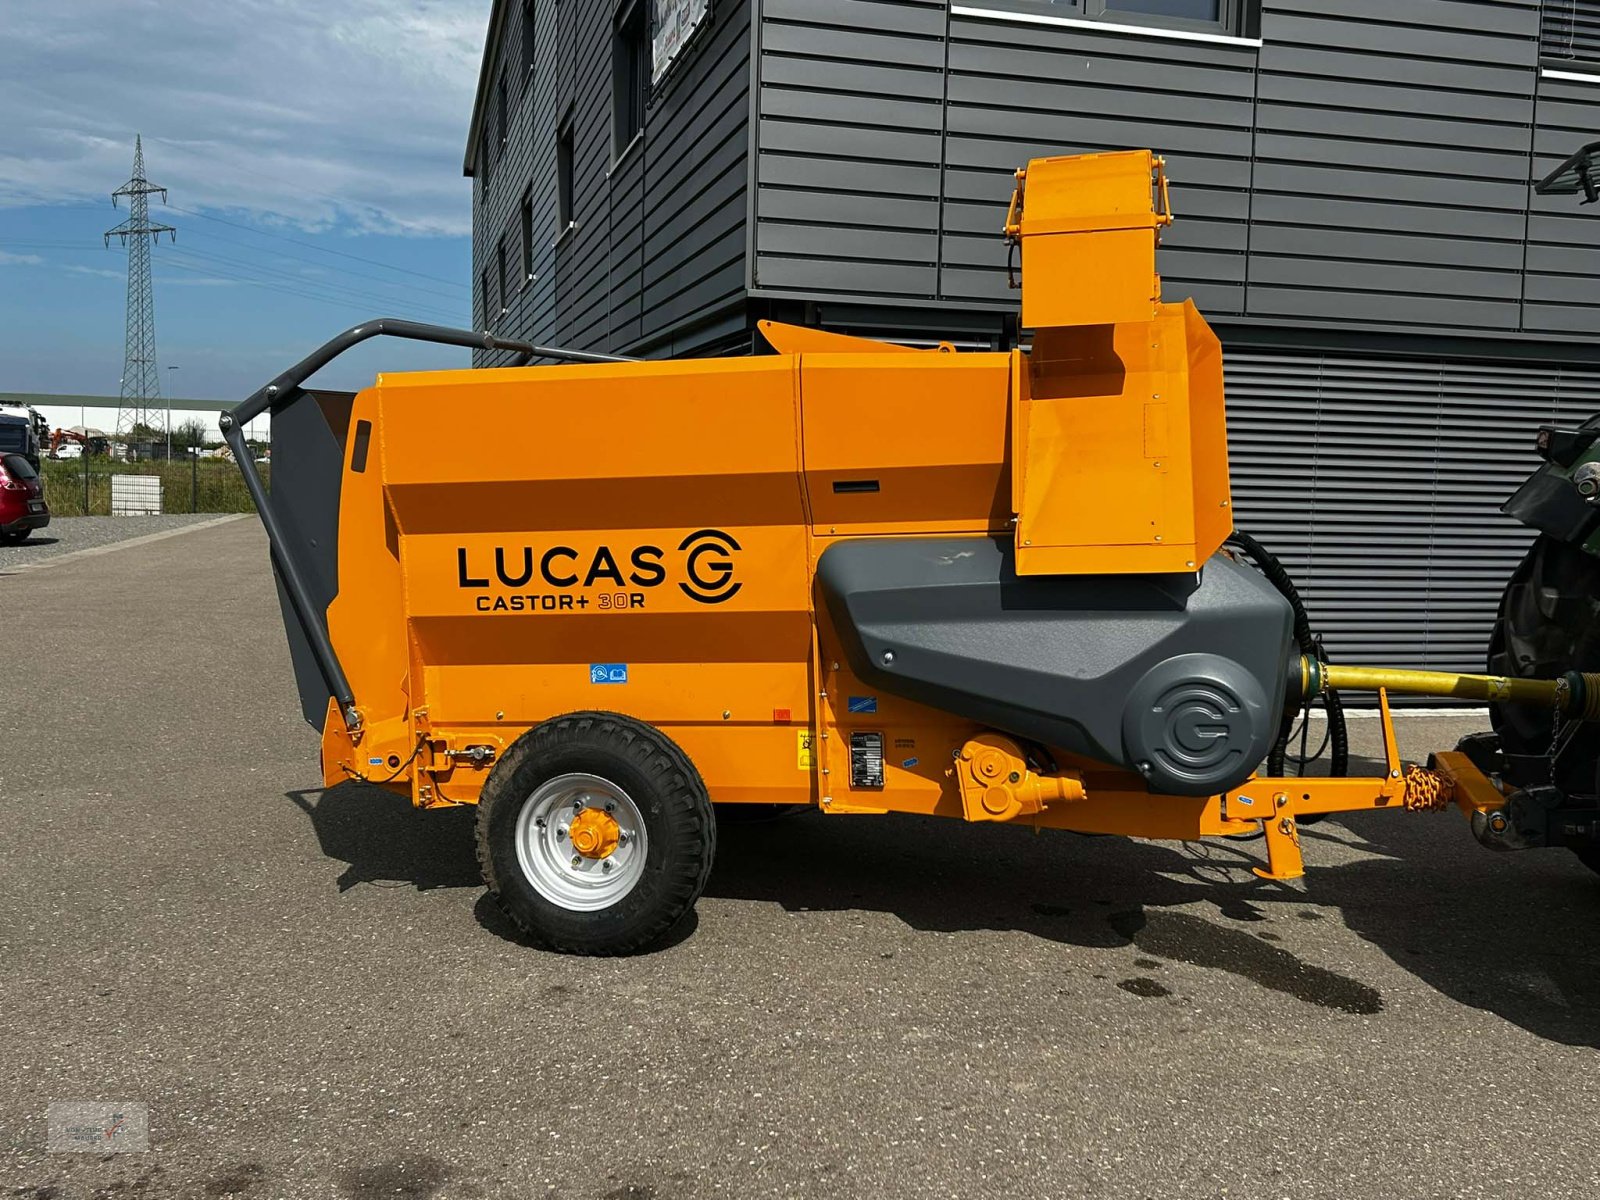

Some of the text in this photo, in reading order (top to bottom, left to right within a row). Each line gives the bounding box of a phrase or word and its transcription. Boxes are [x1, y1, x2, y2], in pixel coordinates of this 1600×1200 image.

[457, 545, 666, 588] LUCAS
[476, 592, 645, 611] CASTOR+ 30R
